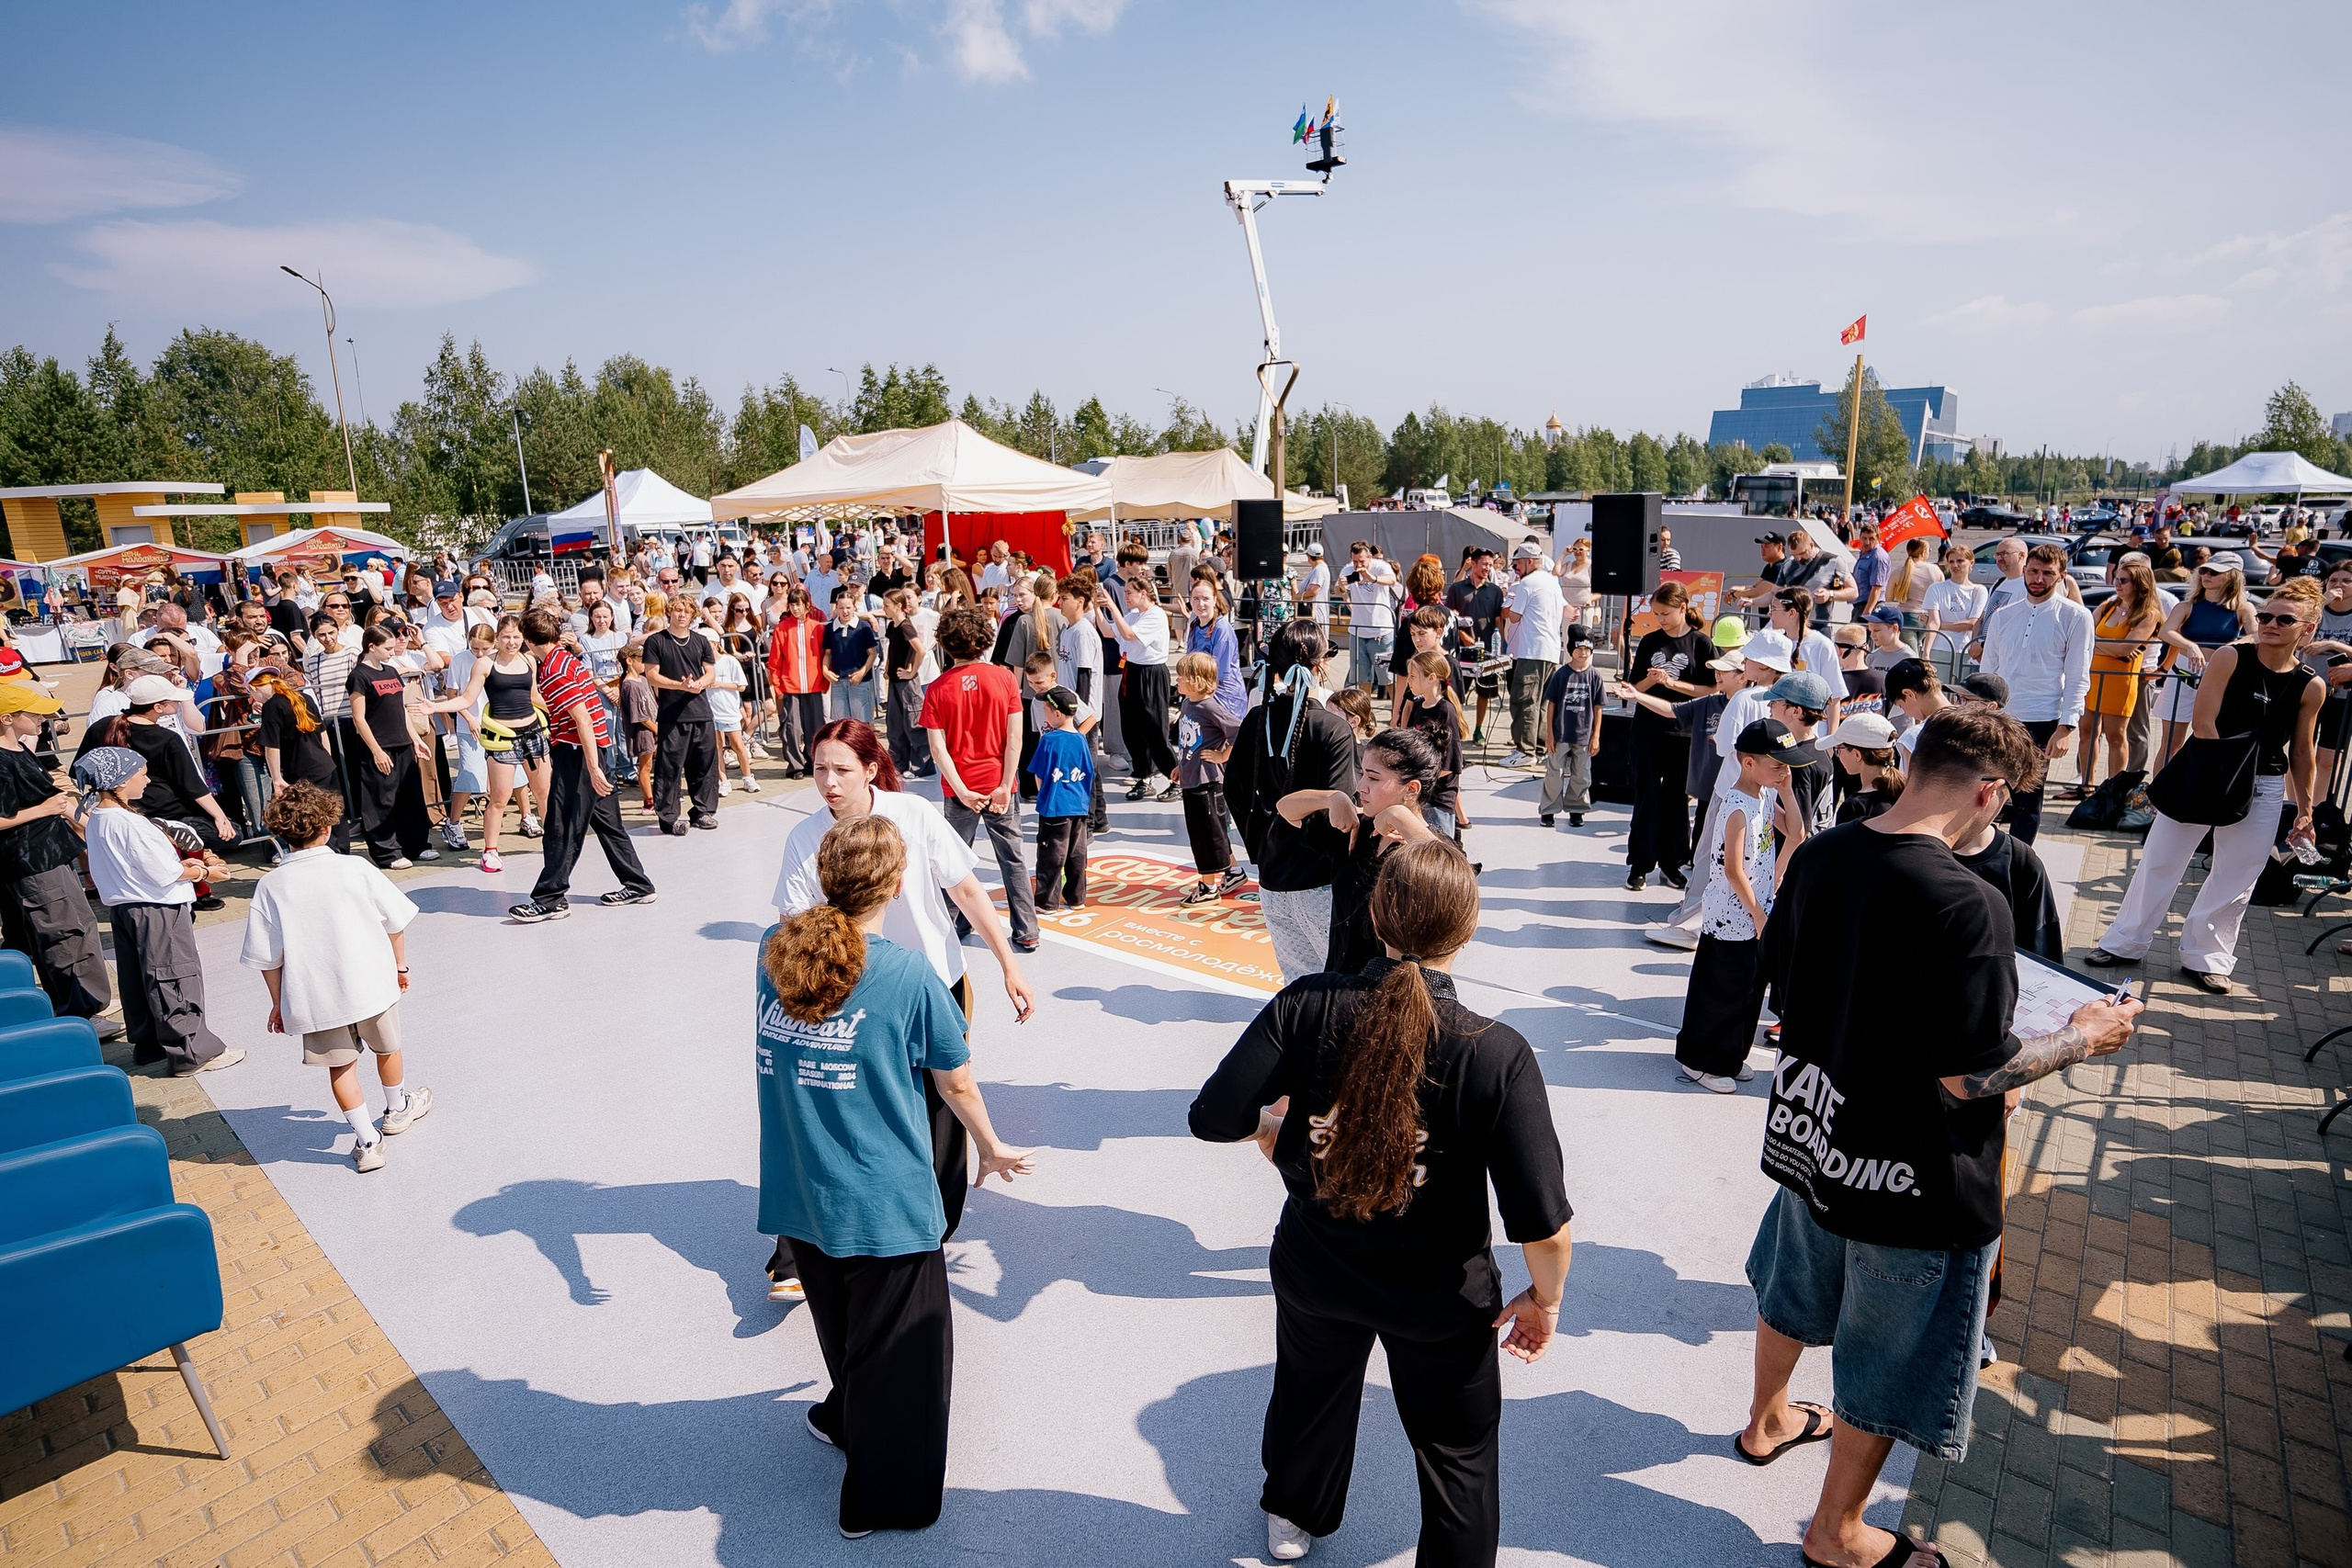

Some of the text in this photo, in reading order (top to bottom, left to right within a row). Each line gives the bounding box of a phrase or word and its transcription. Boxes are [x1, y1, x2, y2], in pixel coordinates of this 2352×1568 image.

[1123, 921, 1186, 942] вместе
[762, 1029, 853, 1052] ENDLESS ADVENTURES
[797, 1068, 825, 1078] SEASON
[820, 1062, 857, 1071] MOSCOW
[797, 1077, 856, 1090] INTERNATIONAL
[1766, 1145, 1780, 1157] TIMES
[1779, 1153, 1789, 1162] DO
[1789, 1157, 1801, 1168] YOU
[1769, 1103, 1921, 1196] BOARDING.
[1769, 1136, 1777, 1145] DO
[1781, 1144, 1811, 1165] SKATEBOARD
[1774, 1161, 1795, 1176] WRONG
[1795, 1171, 1804, 1182] TILL
